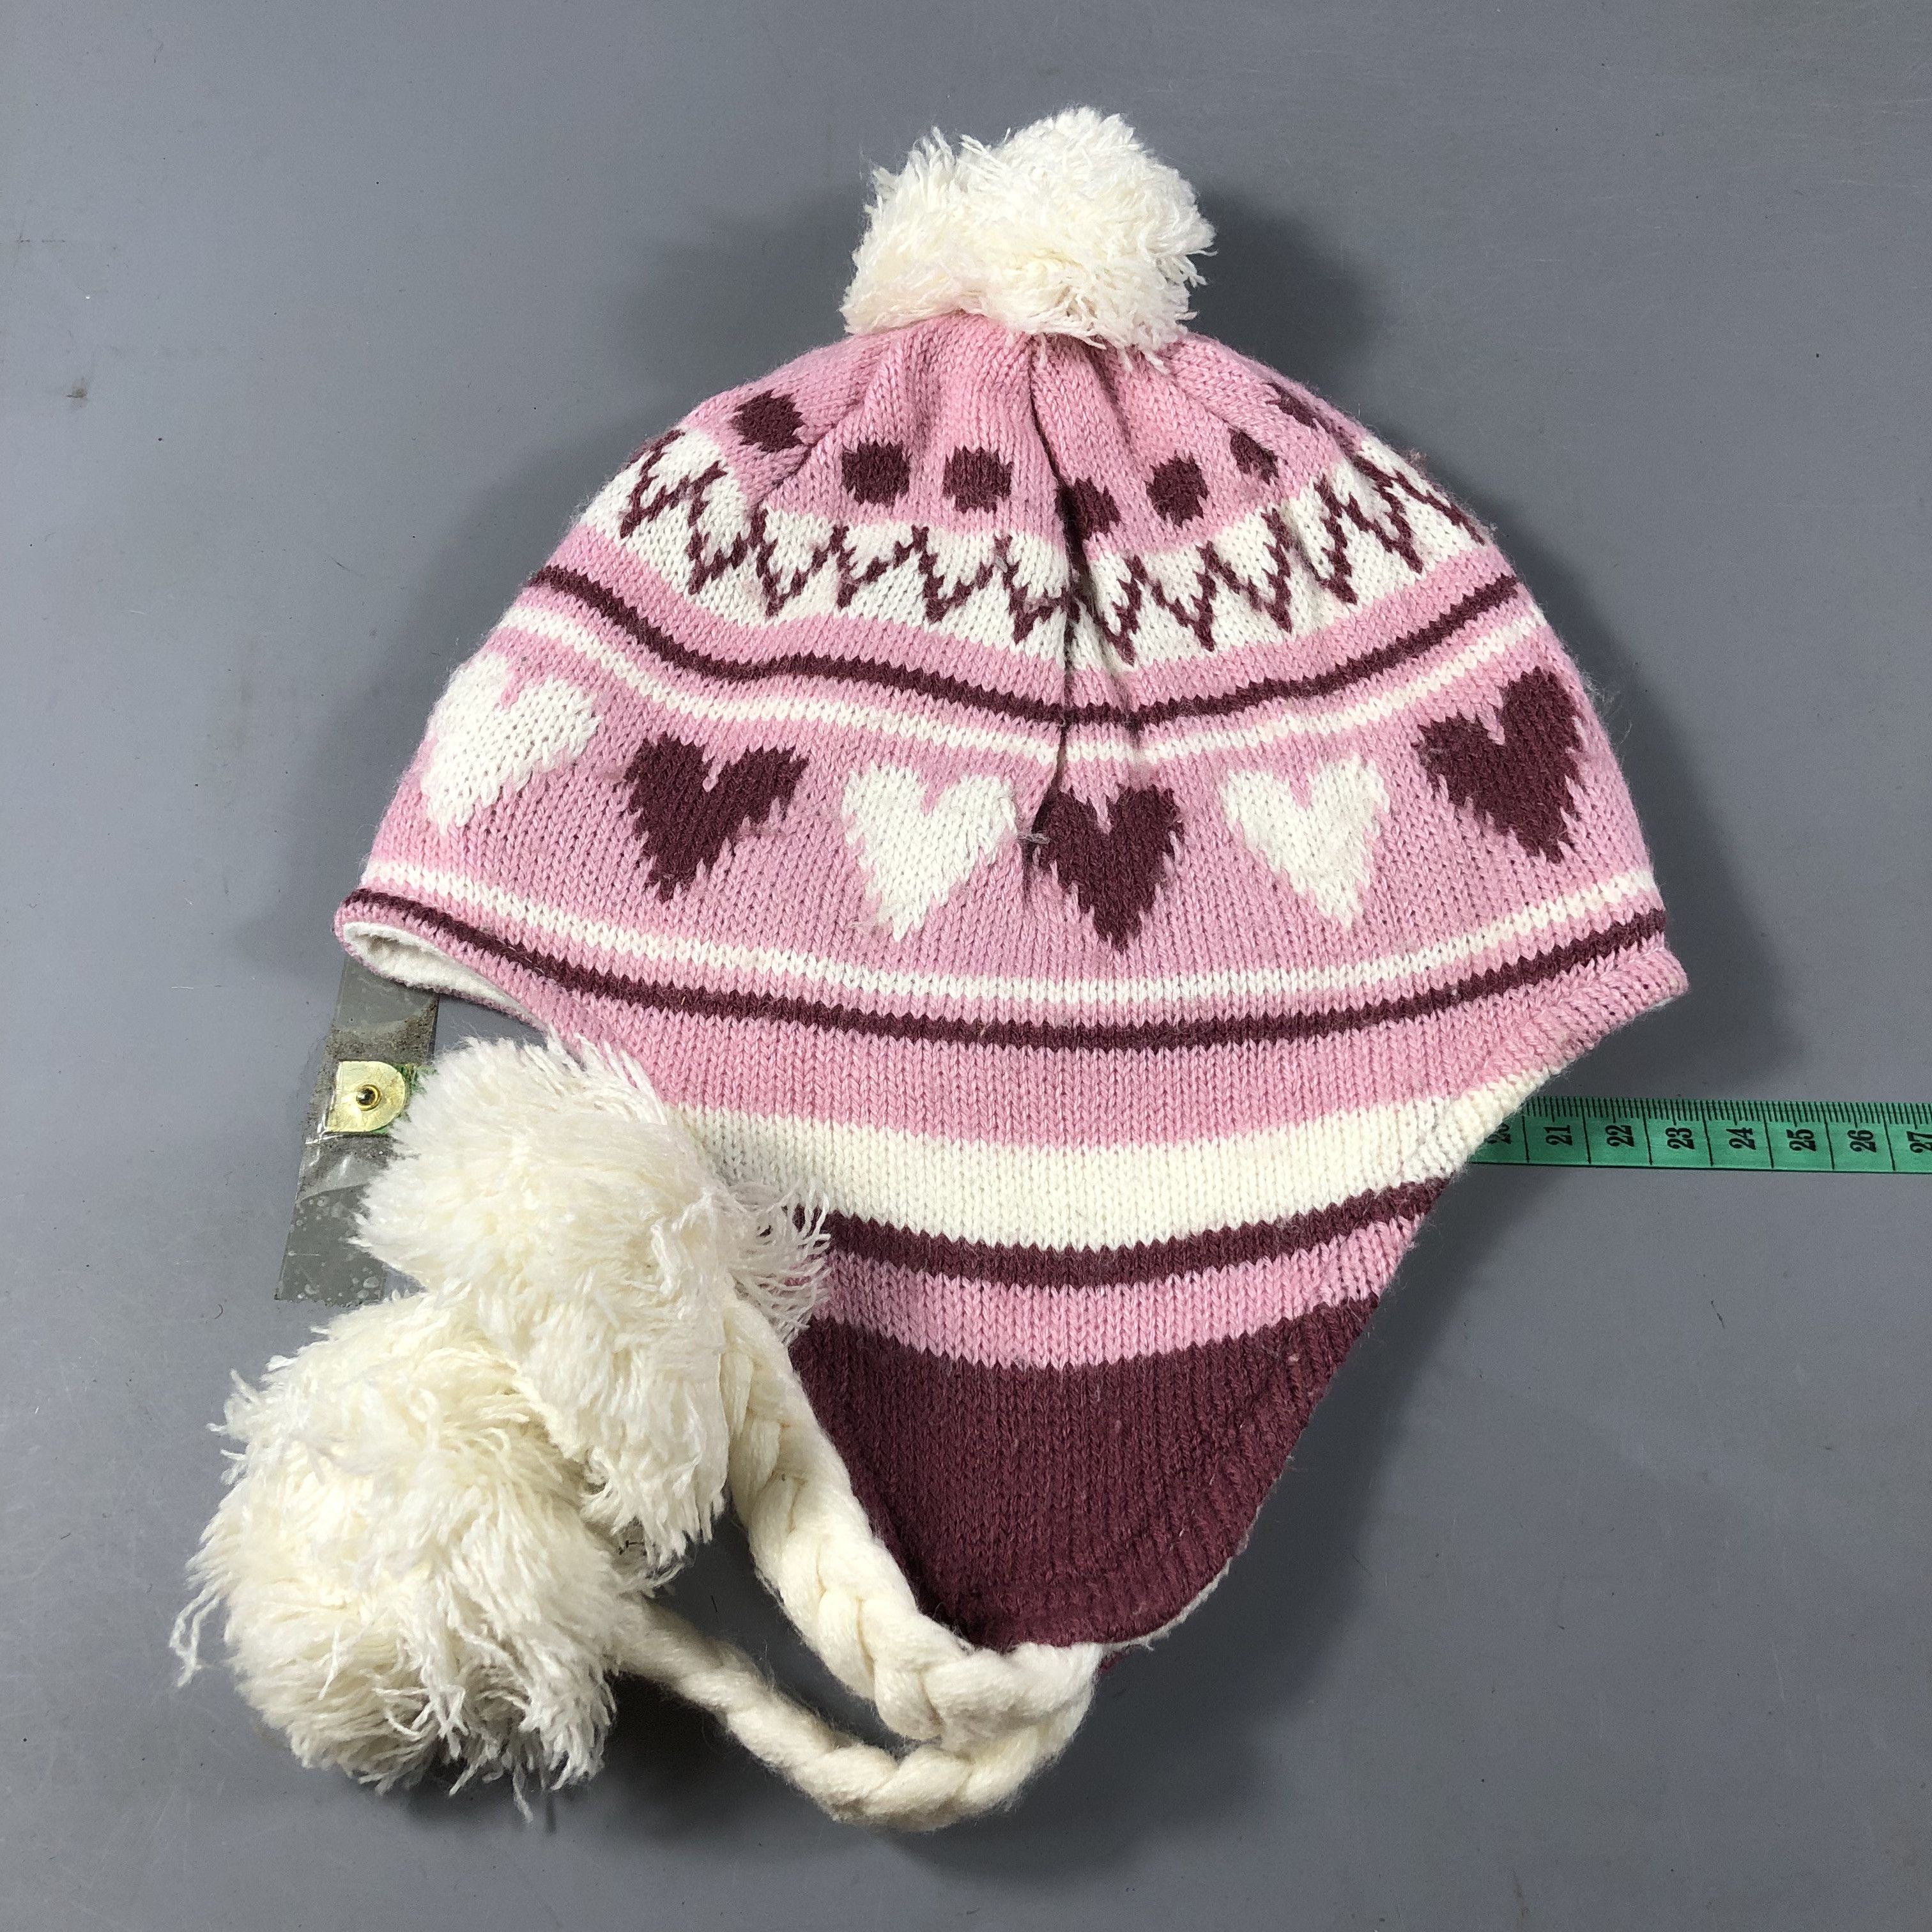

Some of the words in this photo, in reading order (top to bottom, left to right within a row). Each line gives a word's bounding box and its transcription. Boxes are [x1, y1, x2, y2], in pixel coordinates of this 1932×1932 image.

[1543, 1124, 1573, 1146] 21
[1604, 1124, 1635, 1147] 22
[1665, 1127, 1696, 1150] 23
[1726, 1127, 1756, 1151] 24
[1786, 1129, 1817, 1152] 25
[1846, 1130, 1877, 1153] 26
[1906, 1131, 1932, 1153] 27
